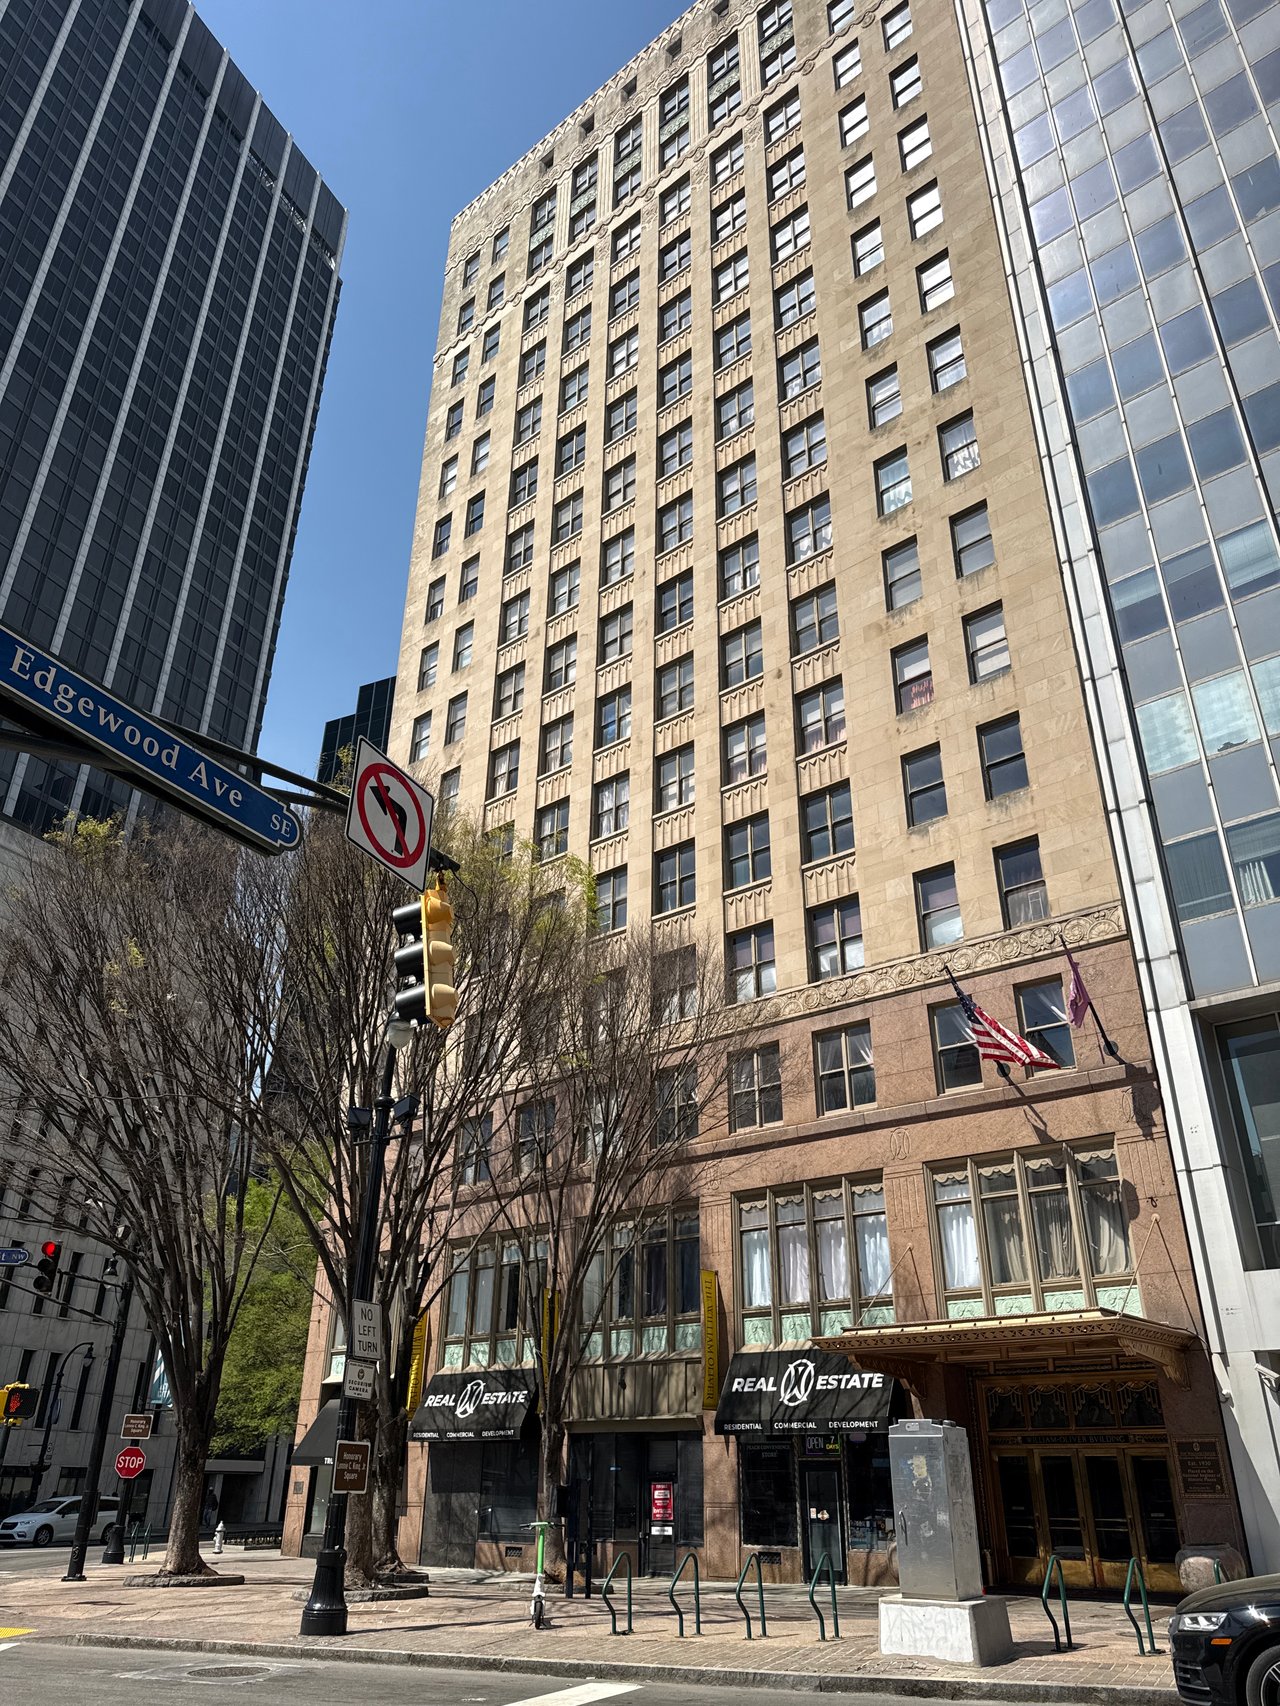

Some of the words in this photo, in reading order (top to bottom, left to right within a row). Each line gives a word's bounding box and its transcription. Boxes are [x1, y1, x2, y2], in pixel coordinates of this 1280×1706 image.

[9, 645, 180, 771] Edgewood
[188, 761, 243, 807] Ave
[270, 813, 291, 837] SE
[704, 1279, 712, 1301] THE
[360, 1307, 373, 1322] NO
[358, 1323, 376, 1338] LEFT
[706, 1305, 714, 1354] WILLIAM
[358, 1340, 378, 1353] TURN
[731, 1376, 777, 1392] REAL
[815, 1373, 884, 1390] ESTATE
[348, 1386, 369, 1394] CAMERA
[424, 1394, 456, 1407] REAL
[481, 1390, 528, 1405] ESTATE
[723, 1422, 763, 1431] RESIDENTIAL
[773, 1421, 817, 1430] COMMERCIAL
[828, 1420, 878, 1429] DEVELOPMENT
[481, 1429, 514, 1437] DEVELOPMENT
[807, 1436, 824, 1449] OPEN
[830, 1435, 835, 1444] 7
[117, 1456, 143, 1468] STOP
[343, 1452, 362, 1462] Honorary
[343, 1471, 358, 1482] Square
